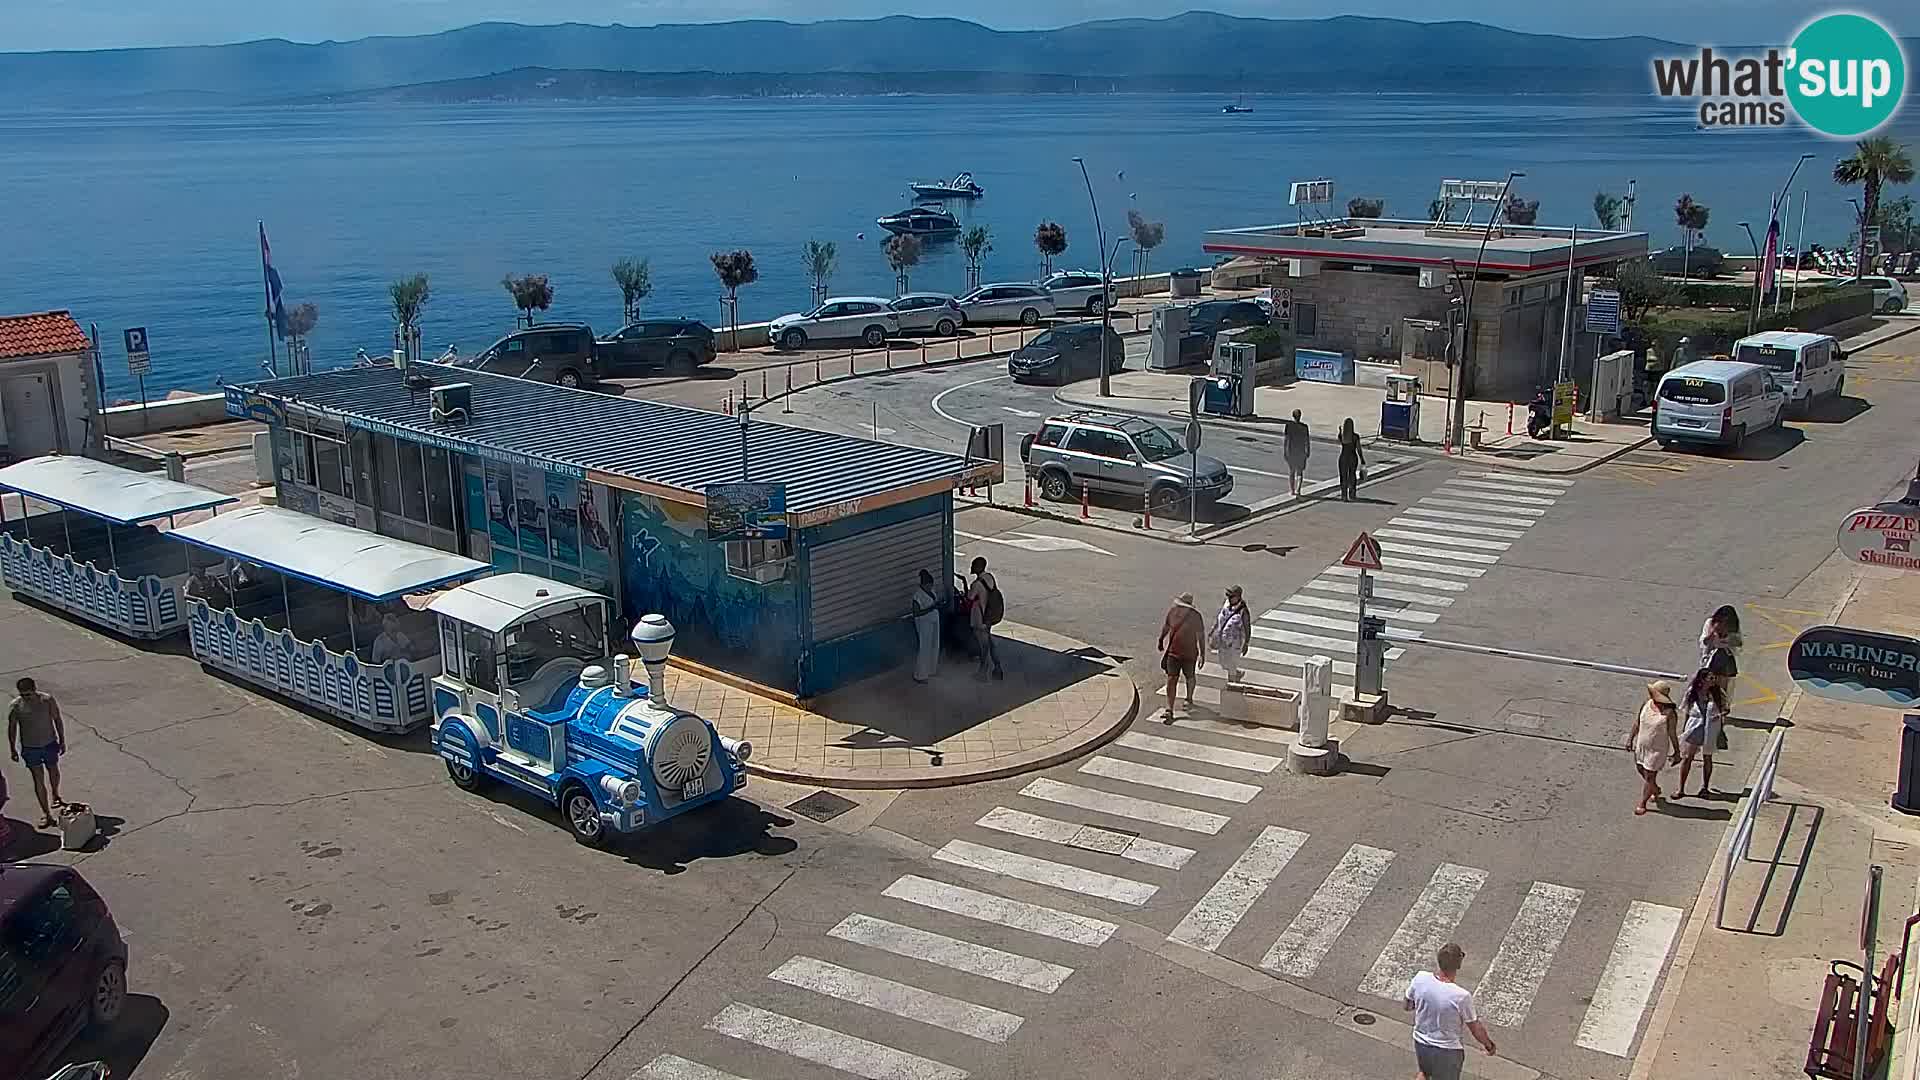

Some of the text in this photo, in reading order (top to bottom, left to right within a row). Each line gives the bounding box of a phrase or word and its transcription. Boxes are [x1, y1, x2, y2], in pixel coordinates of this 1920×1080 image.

[129, 331, 141, 349] P
[1759, 348, 1776, 356] TAXI
[1685, 379, 1704, 387] TAXI
[437, 438, 468, 452] POSTAJA
[478, 447, 493, 458] BUS
[494, 450, 526, 465] STATION
[529, 458, 553, 471] TICKET
[555, 462, 582, 477] OFFICE
[1849, 514, 1920, 533] PIZZE
[1801, 642, 1920, 673] MARINER
[1871, 666, 1896, 680] bar
